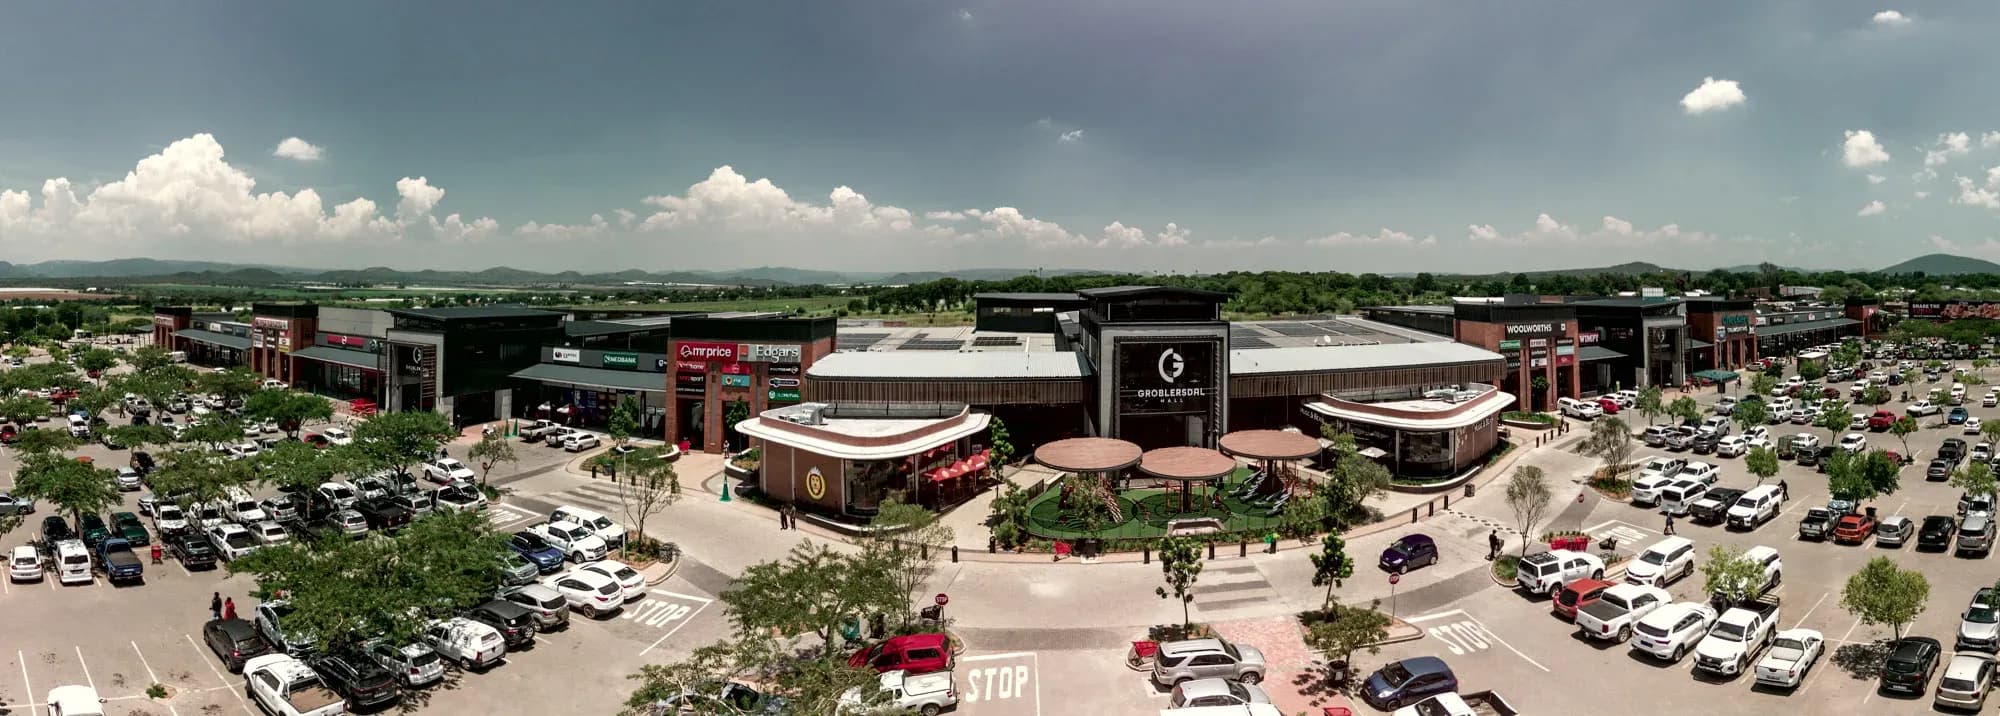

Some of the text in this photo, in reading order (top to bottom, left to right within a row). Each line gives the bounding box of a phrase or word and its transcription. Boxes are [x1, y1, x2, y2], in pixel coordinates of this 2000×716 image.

[1506, 323, 1552, 334] WOOLWORTHS
[610, 355, 637, 364] NEDBANK
[756, 344, 799, 363] Edgars
[1137, 388, 1205, 398] GROBLERSDAL
[622, 598, 692, 628] STOP
[1428, 620, 1493, 655] STOP
[965, 665, 1029, 703] STOP
